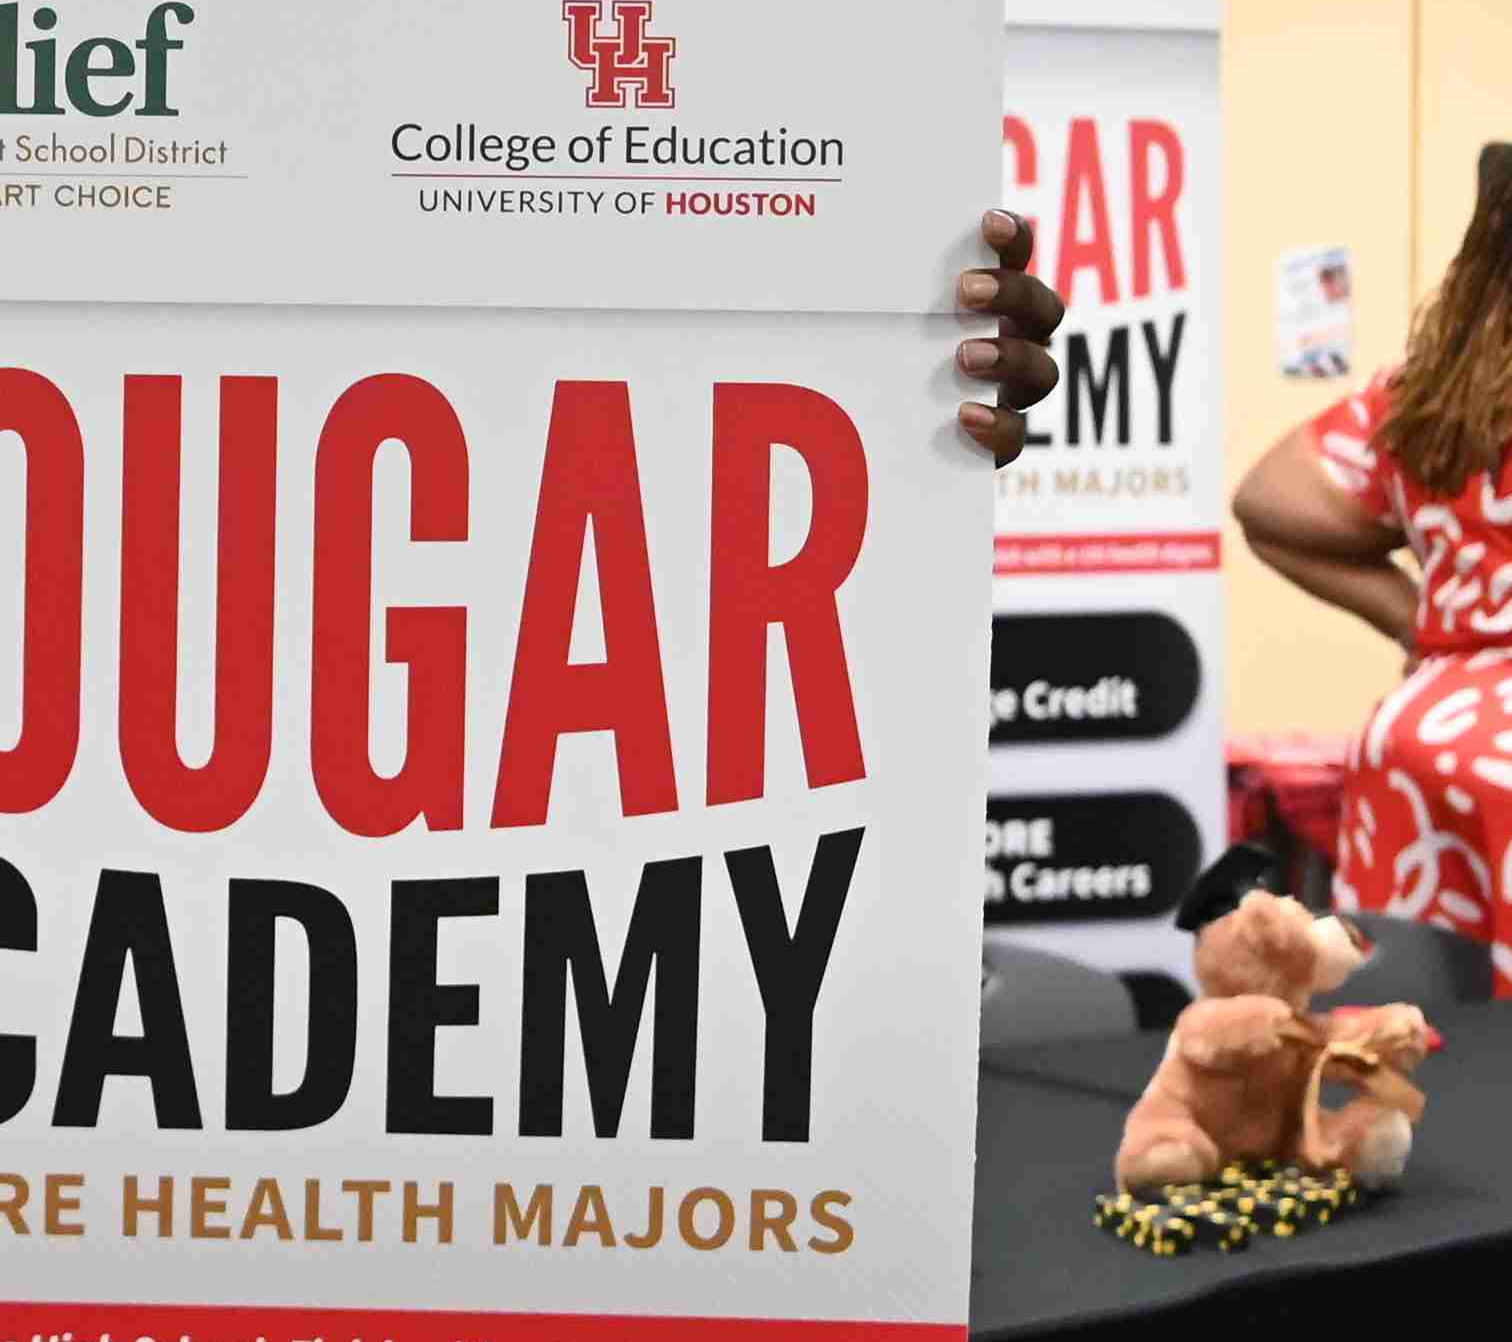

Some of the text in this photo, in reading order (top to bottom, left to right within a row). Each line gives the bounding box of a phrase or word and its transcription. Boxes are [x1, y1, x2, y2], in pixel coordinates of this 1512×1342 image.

[561, 0, 677, 110] UH
[15, 132, 115, 165] School
[124, 135, 228, 166] District
[391, 122, 843, 170] College of Education
[54, 184, 171, 209] CHOICE
[419, 189, 816, 216] UNIVERSITY OF HOUSTON
[1053, 465, 1192, 498] MAJORS
[1022, 675, 1140, 722] Credit
[1009, 861, 1153, 903] Careers
[122, 1175, 454, 1244] HEALTH
[492, 1183, 854, 1255] MAJORS
